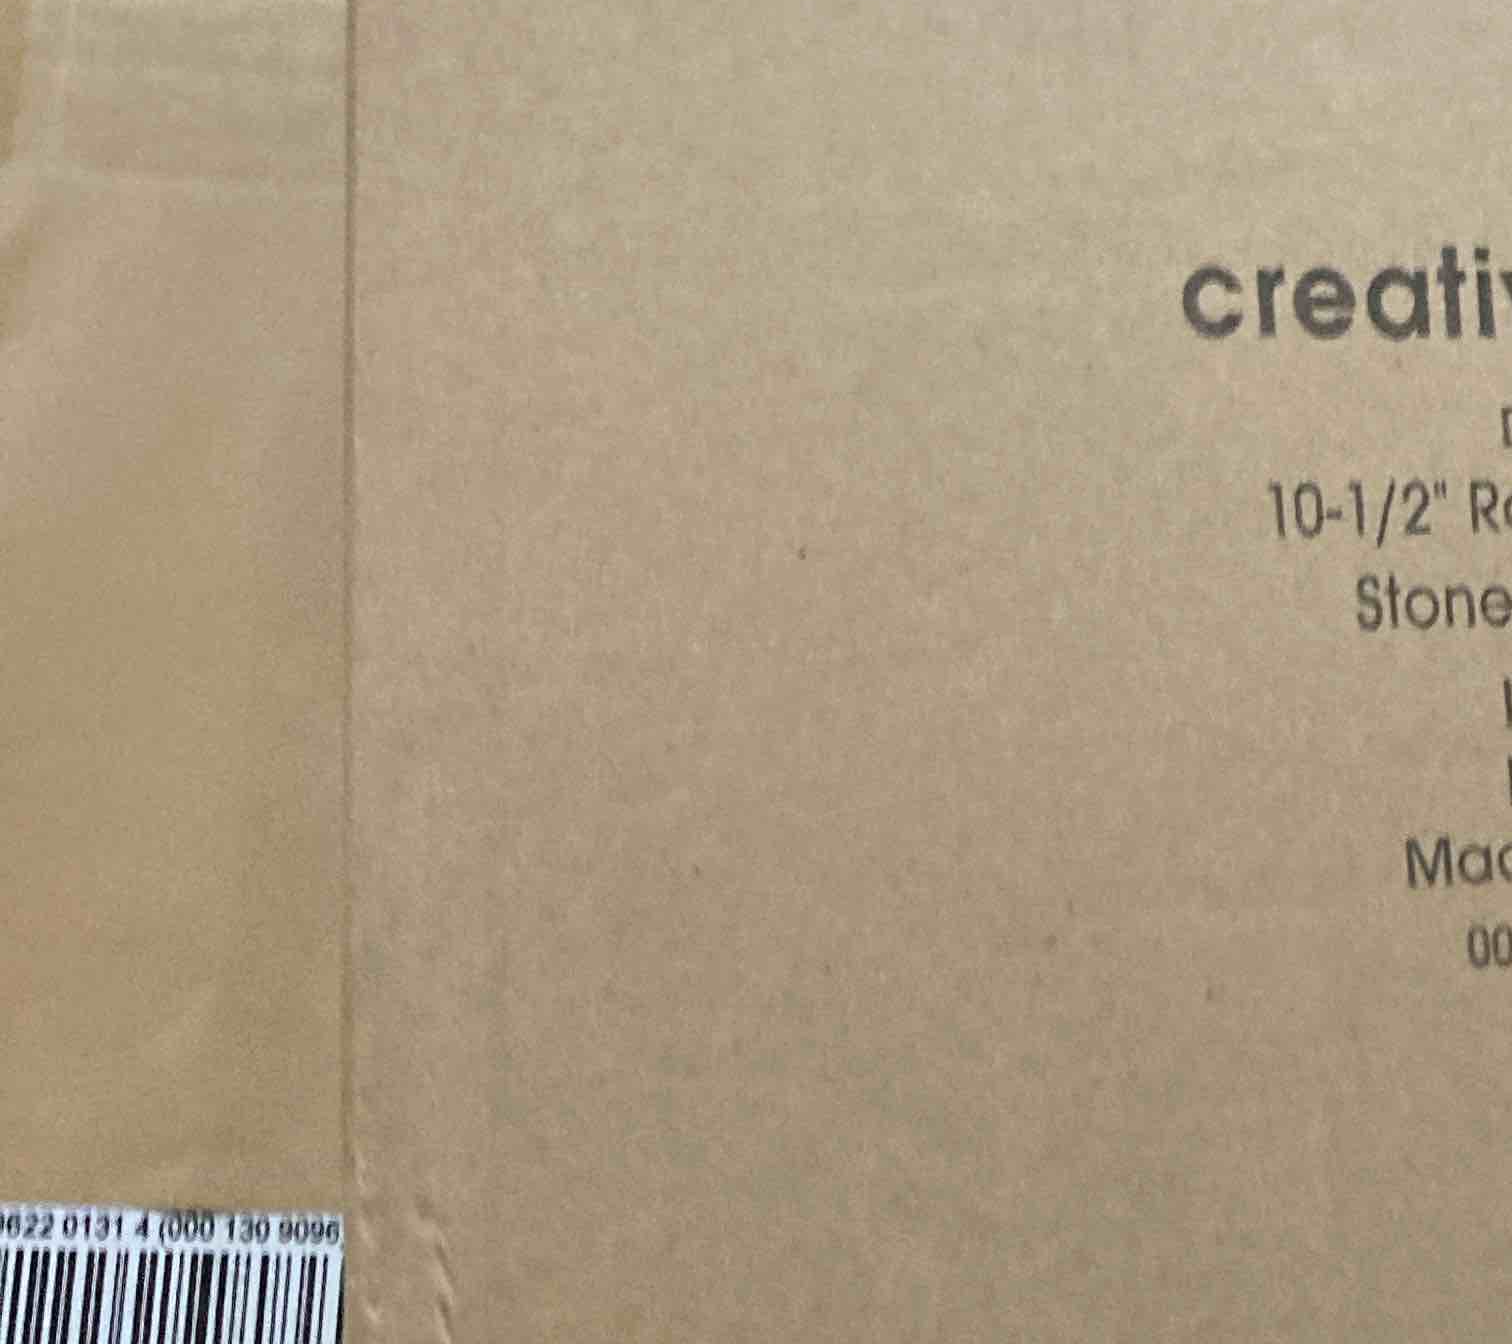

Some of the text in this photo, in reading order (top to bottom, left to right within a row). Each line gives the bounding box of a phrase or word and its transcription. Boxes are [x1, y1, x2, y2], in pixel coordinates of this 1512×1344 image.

[1268, 476, 1448, 548] 10-1/2"
[62, 1213, 123, 1241] 0131
[135, 1215, 149, 1240] 4
[227, 1215, 271, 1245] 130
